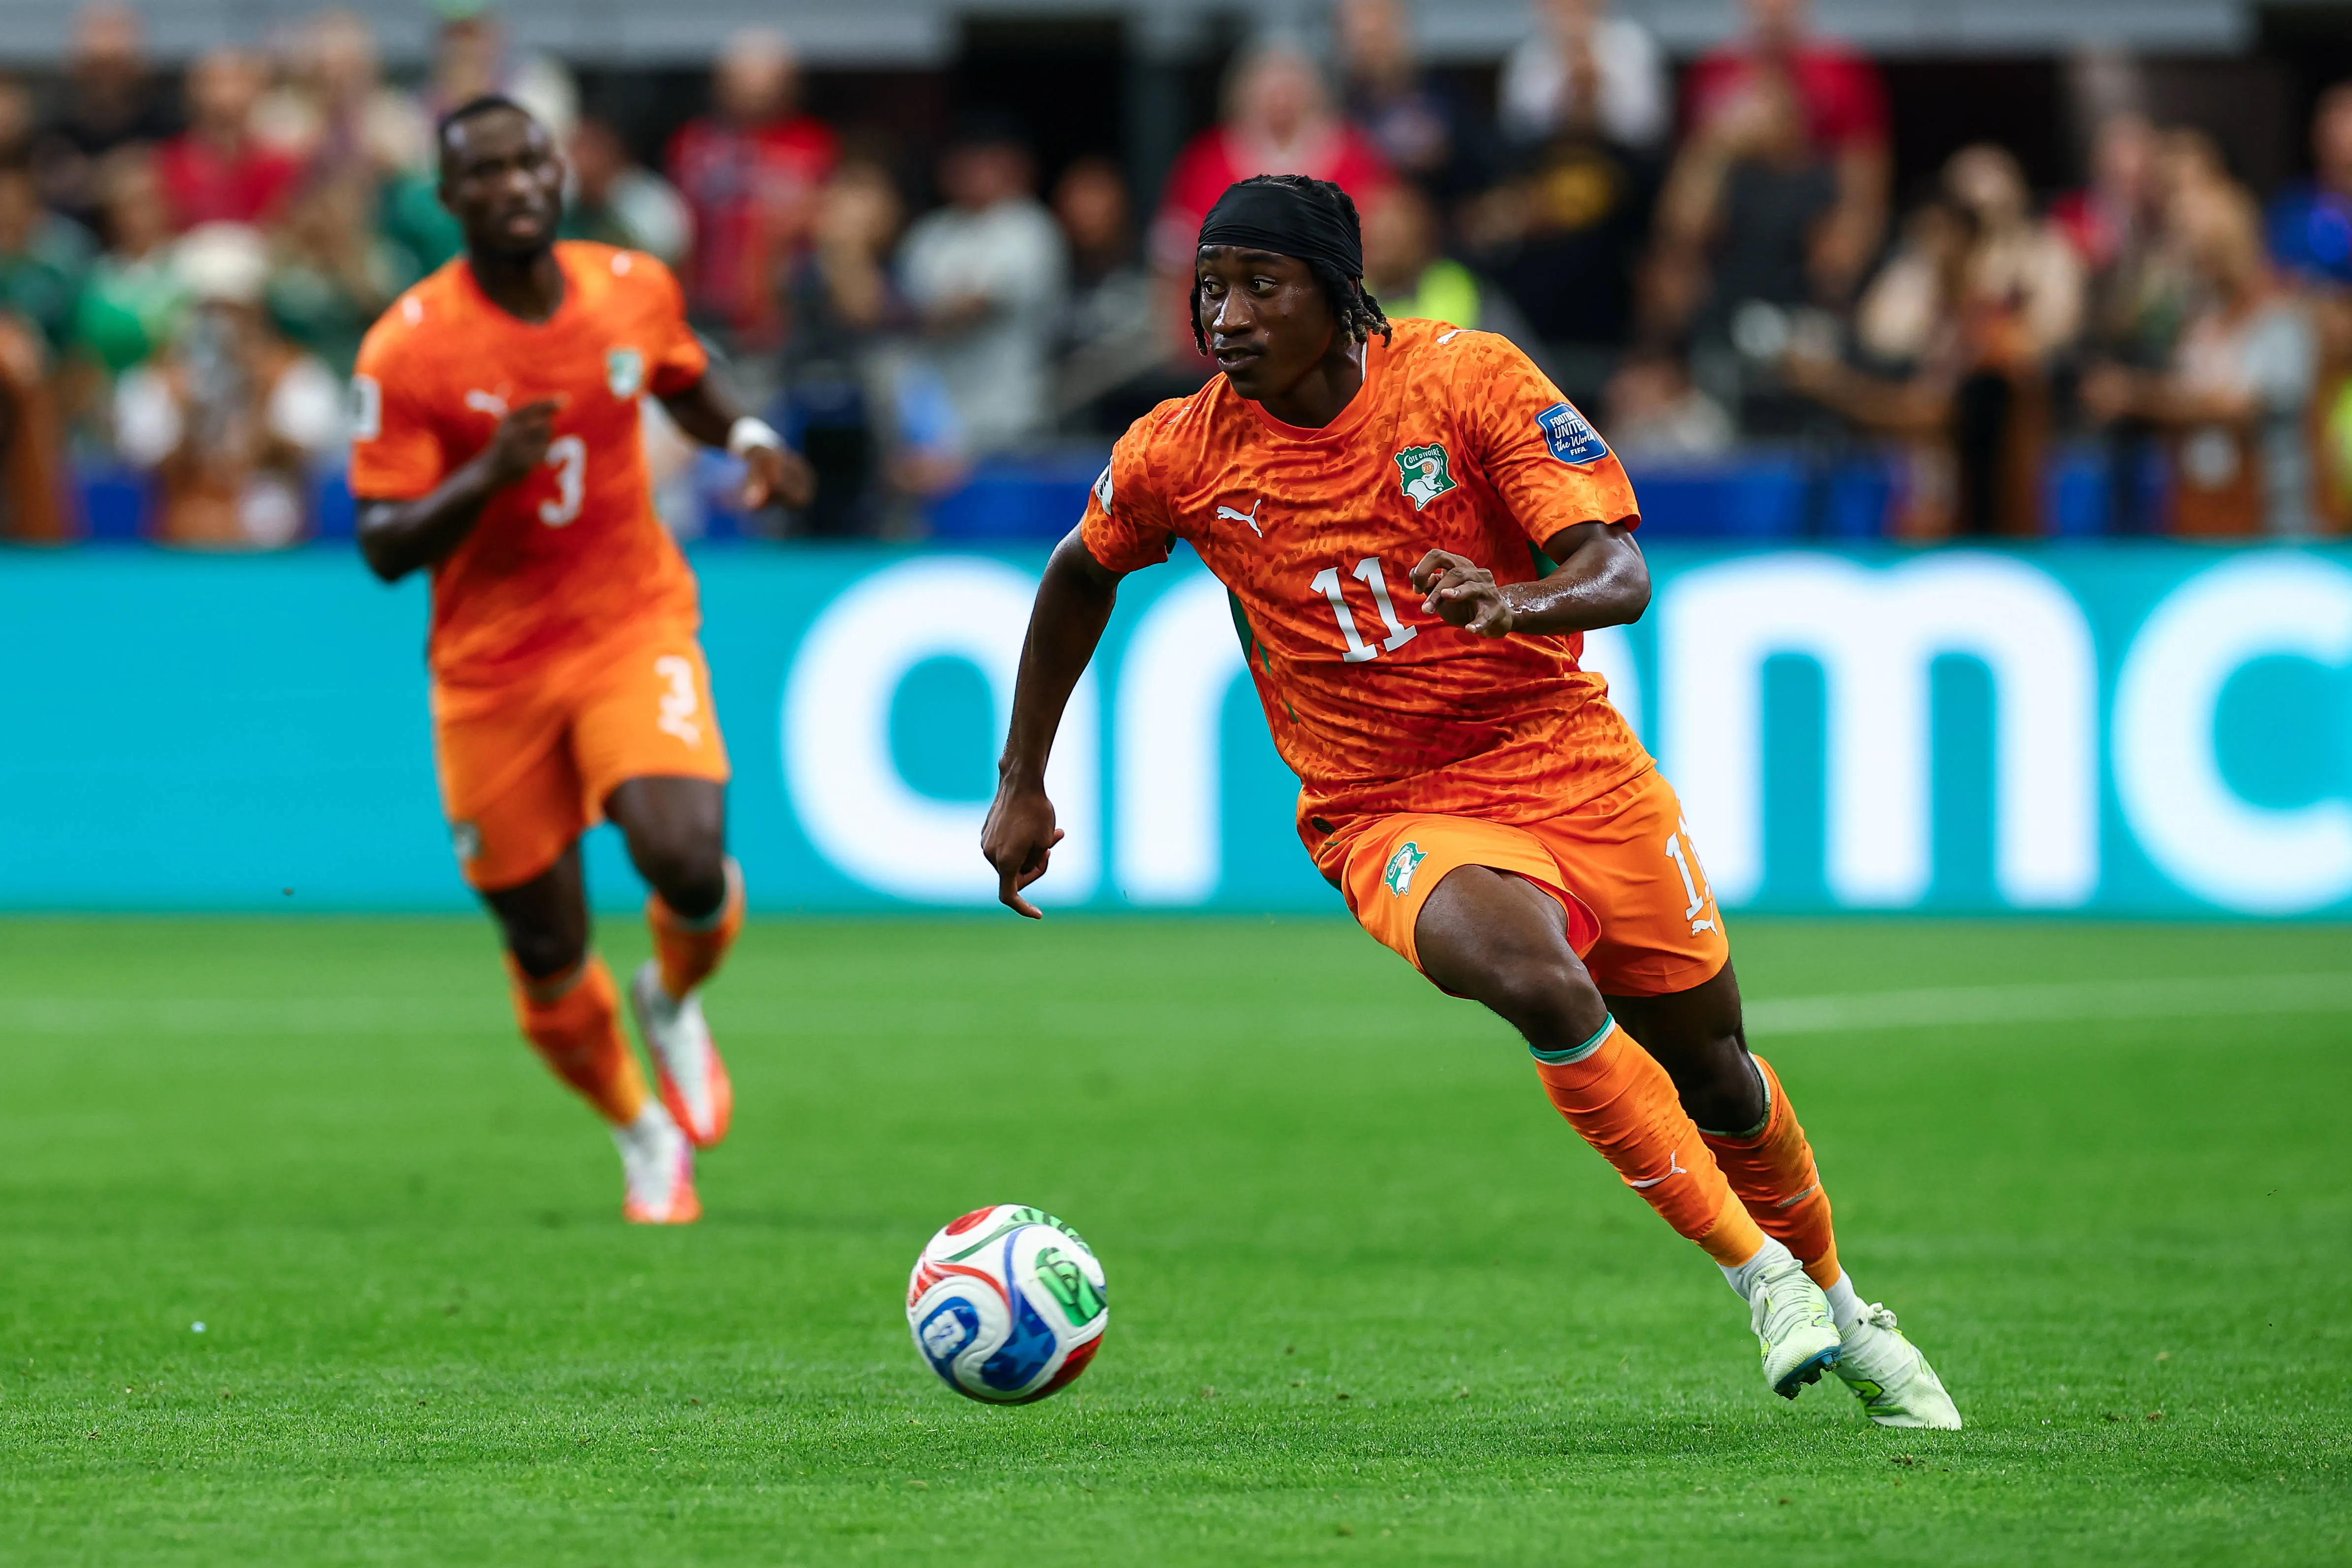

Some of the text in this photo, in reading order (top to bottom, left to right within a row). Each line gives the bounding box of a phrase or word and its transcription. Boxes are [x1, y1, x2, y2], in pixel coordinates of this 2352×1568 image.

[1554, 419, 1587, 439] UNITES
[1554, 430, 1596, 452] the World
[1570, 446, 1587, 456] FIFA
[539, 435, 587, 526] 3
[1309, 556, 1417, 662] 11
